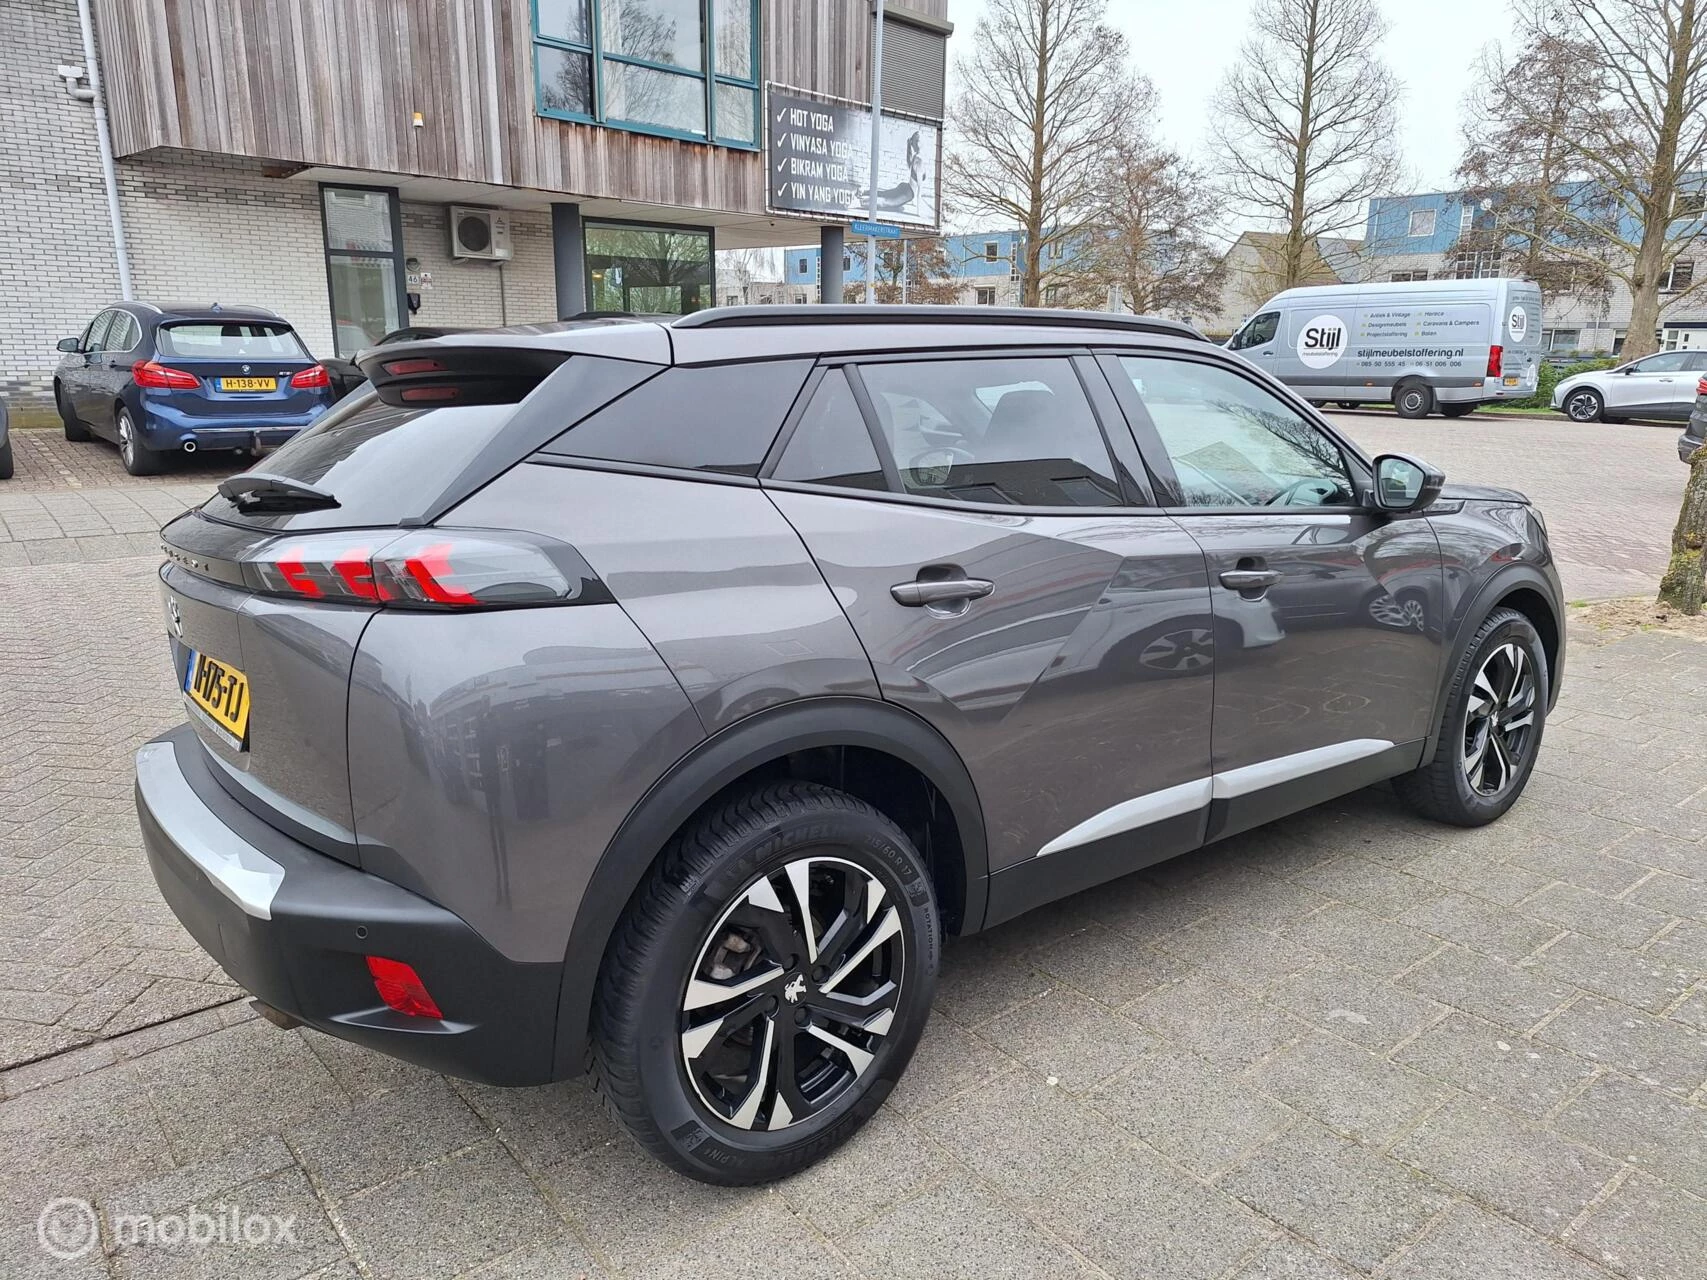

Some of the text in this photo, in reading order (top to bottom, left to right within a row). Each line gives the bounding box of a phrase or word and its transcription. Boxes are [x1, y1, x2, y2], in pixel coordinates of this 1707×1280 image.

[790, 108, 834, 133] HOT YOGA
[790, 133, 853, 160] VINYASA YOGA
[790, 157, 848, 182] BIKRAM YOGA
[791, 182, 857, 205] YIN YANG YOGA
[408, 275, 418, 283] 46
[1367, 321, 1407, 329] Designmeubels
[1304, 327, 1342, 350] Stijl
[1357, 348, 1464, 359] stijlmeubelstoffering.nl
[226, 379, 270, 388] H-138-VV
